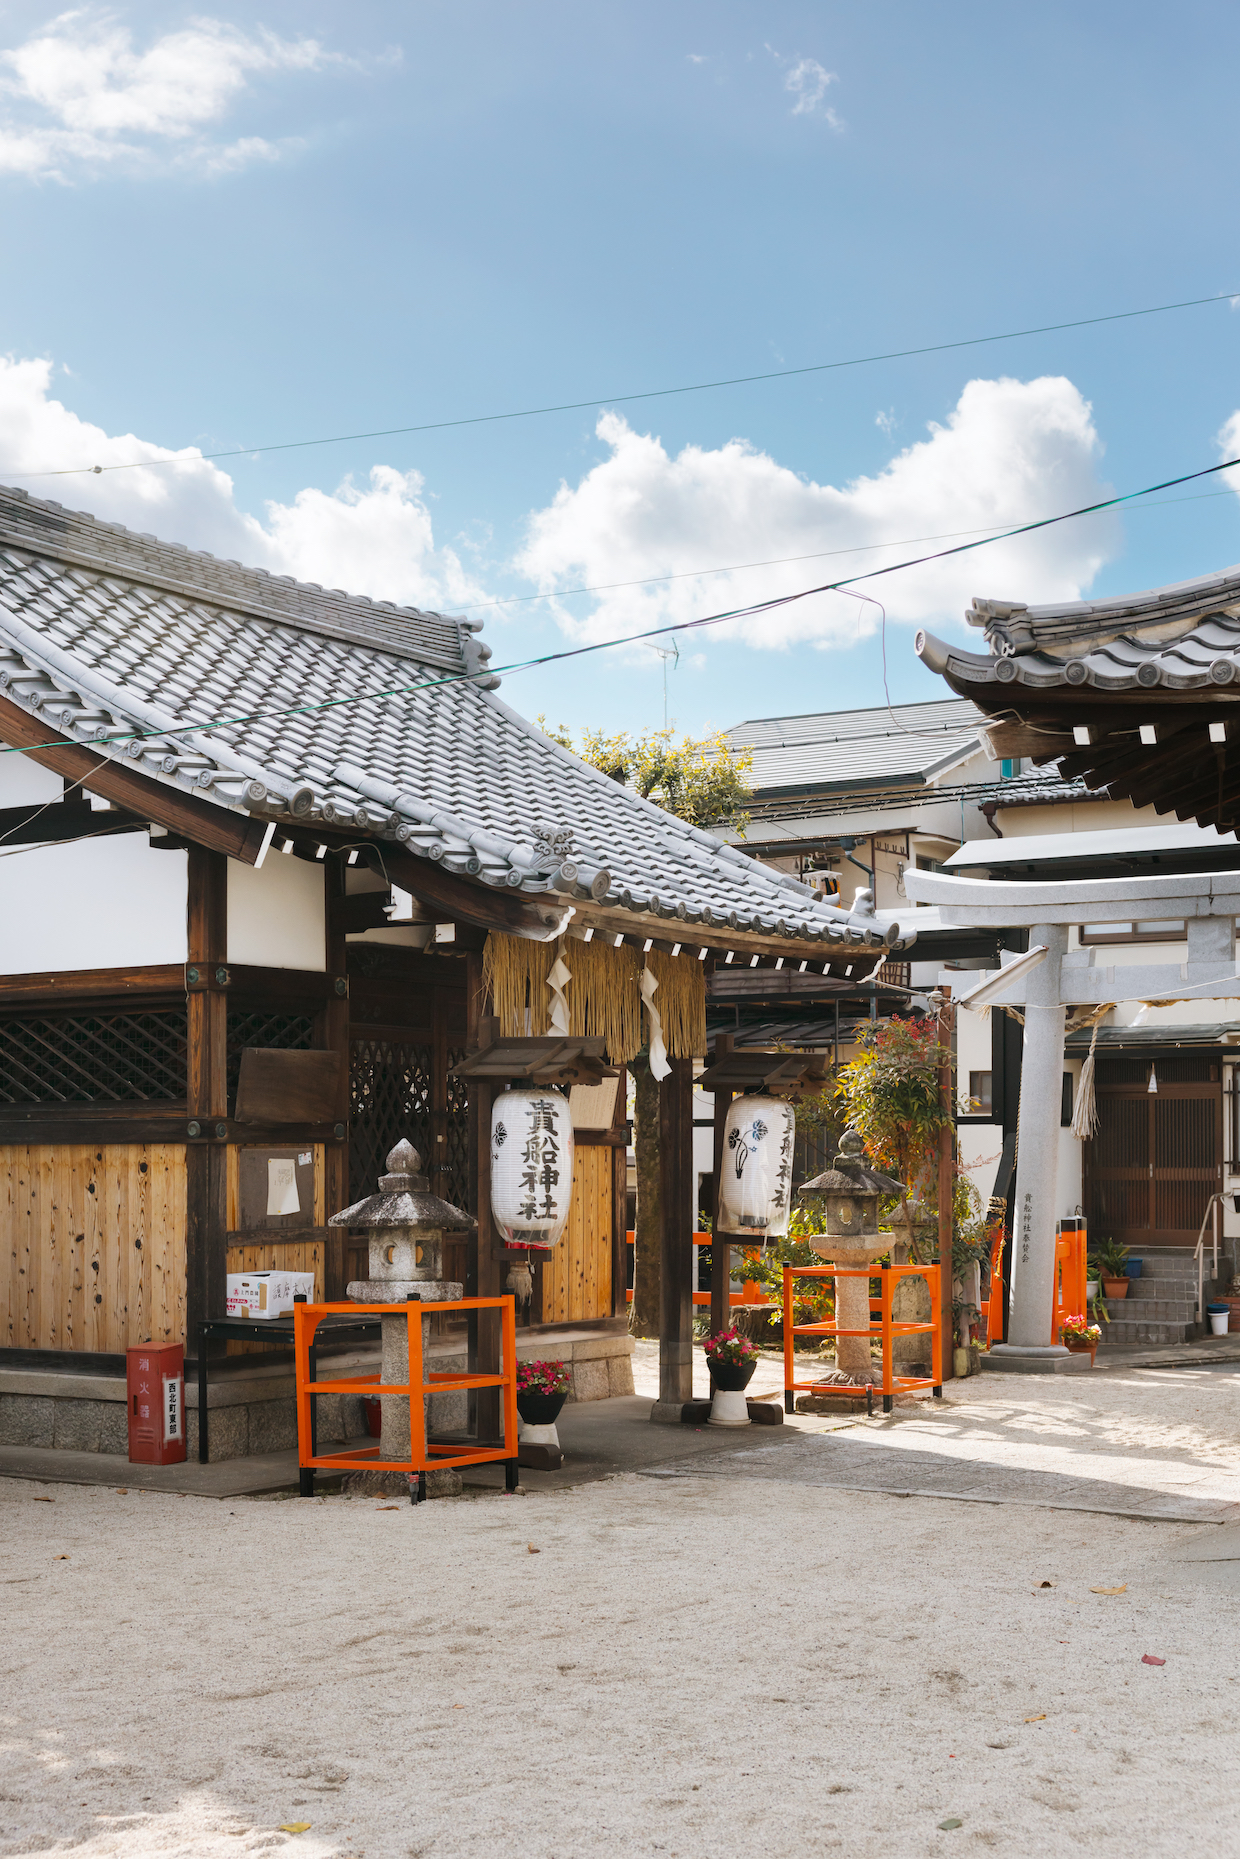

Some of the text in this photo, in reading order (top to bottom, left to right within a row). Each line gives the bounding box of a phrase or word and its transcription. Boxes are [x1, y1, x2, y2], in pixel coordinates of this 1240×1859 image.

[516, 1099, 560, 1221] 貴船神社
[138, 1358, 150, 1419] 消火器
[168, 1382, 177, 1435] 西北町東部
